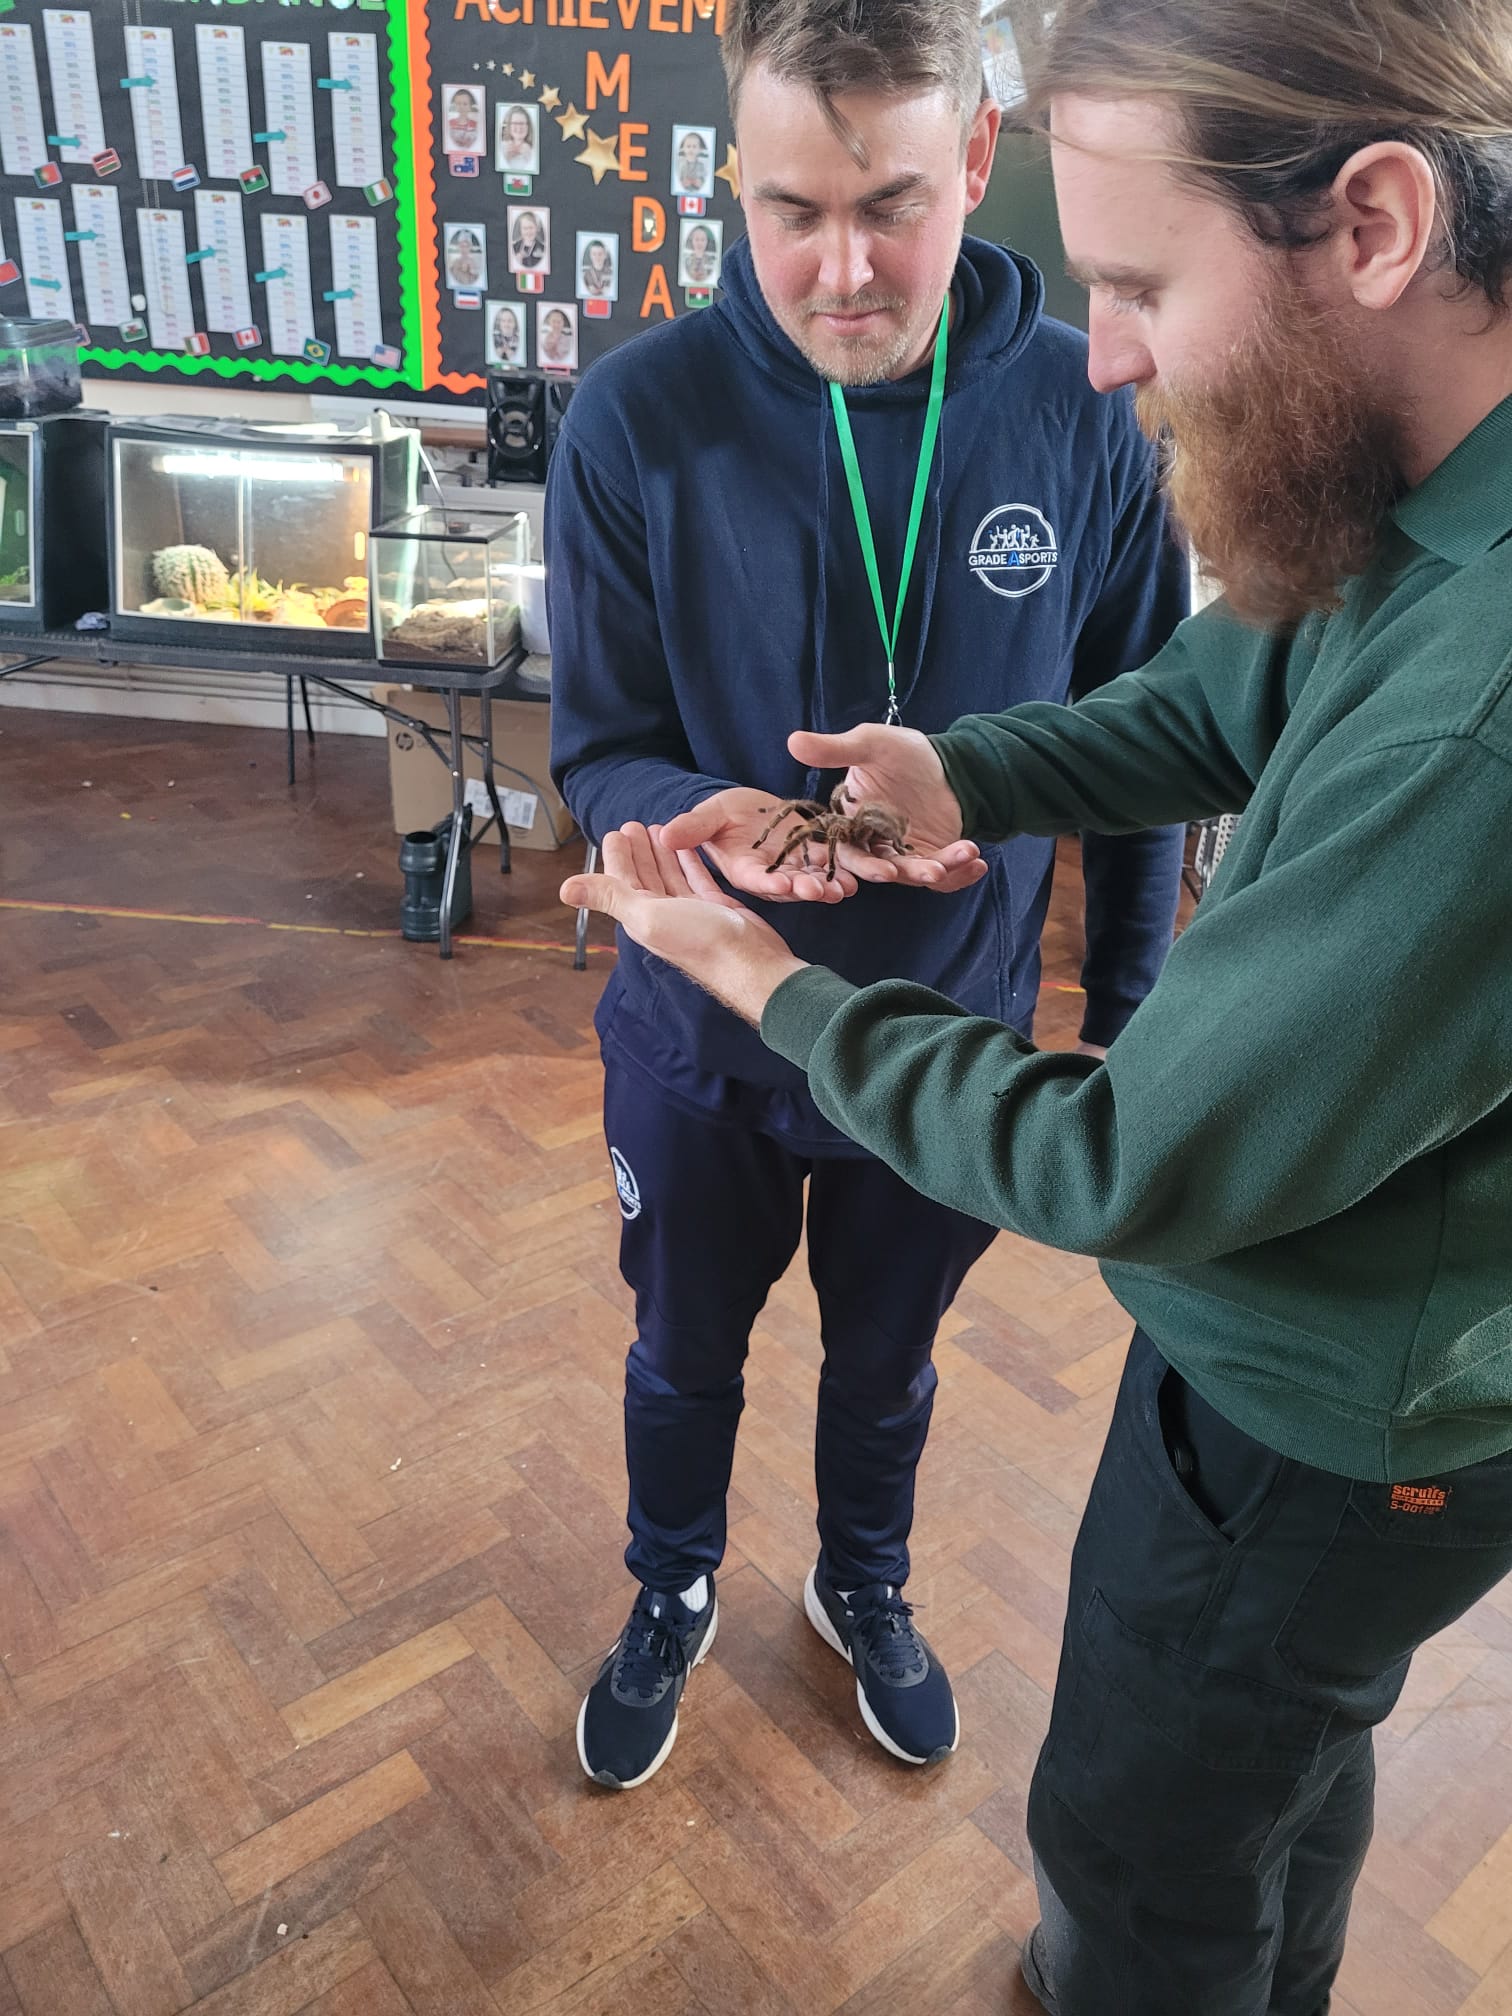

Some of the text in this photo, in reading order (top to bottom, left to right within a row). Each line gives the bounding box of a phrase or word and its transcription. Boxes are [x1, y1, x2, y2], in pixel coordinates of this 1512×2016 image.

[968, 551, 1058, 566] GRADE A SPORTS
